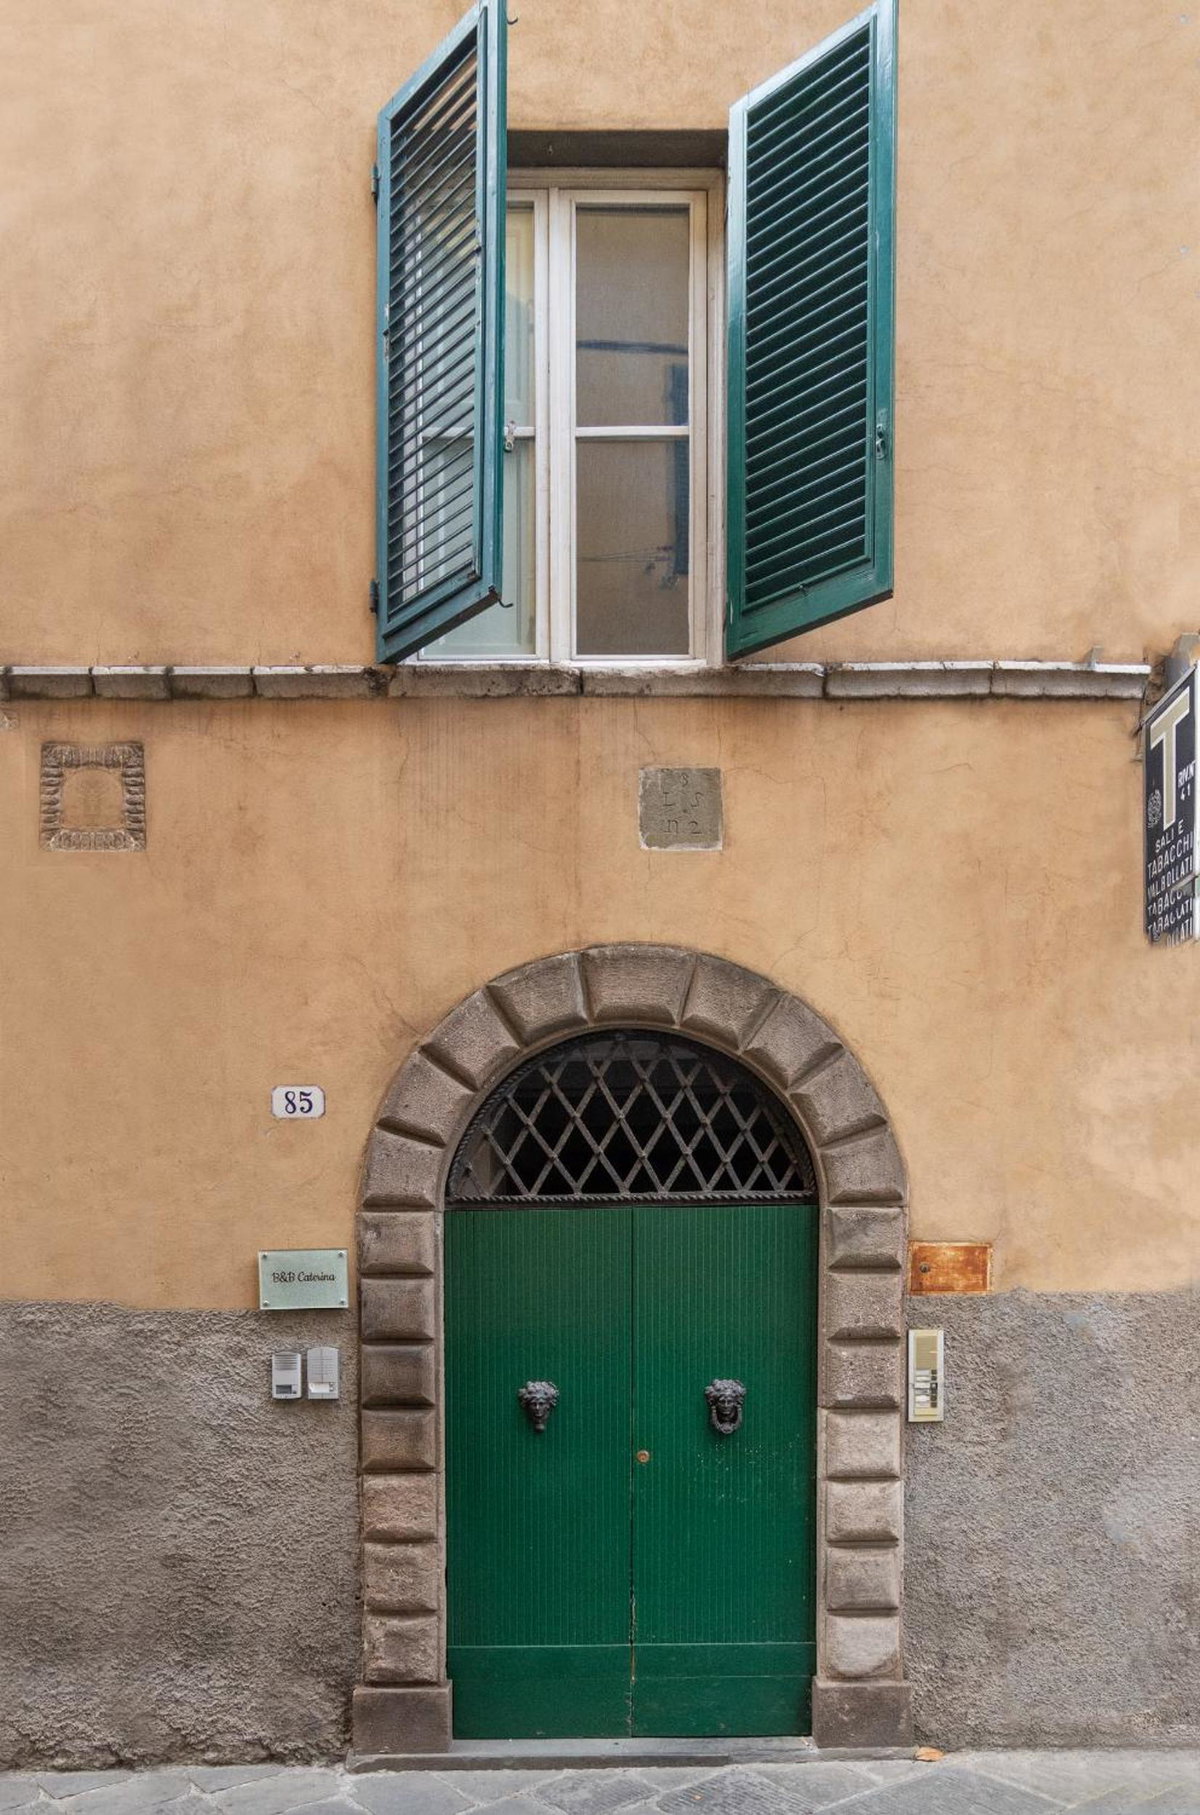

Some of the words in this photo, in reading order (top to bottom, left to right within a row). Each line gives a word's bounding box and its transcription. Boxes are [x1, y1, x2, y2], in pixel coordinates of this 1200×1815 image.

[1150, 686, 1190, 832] T
[1155, 827, 1174, 853] SALI
[1178, 818, 1184, 835] E
[1147, 831, 1193, 880] TABACCHI
[284, 1090, 313, 1115] 85
[271, 1271, 296, 1284] B&B
